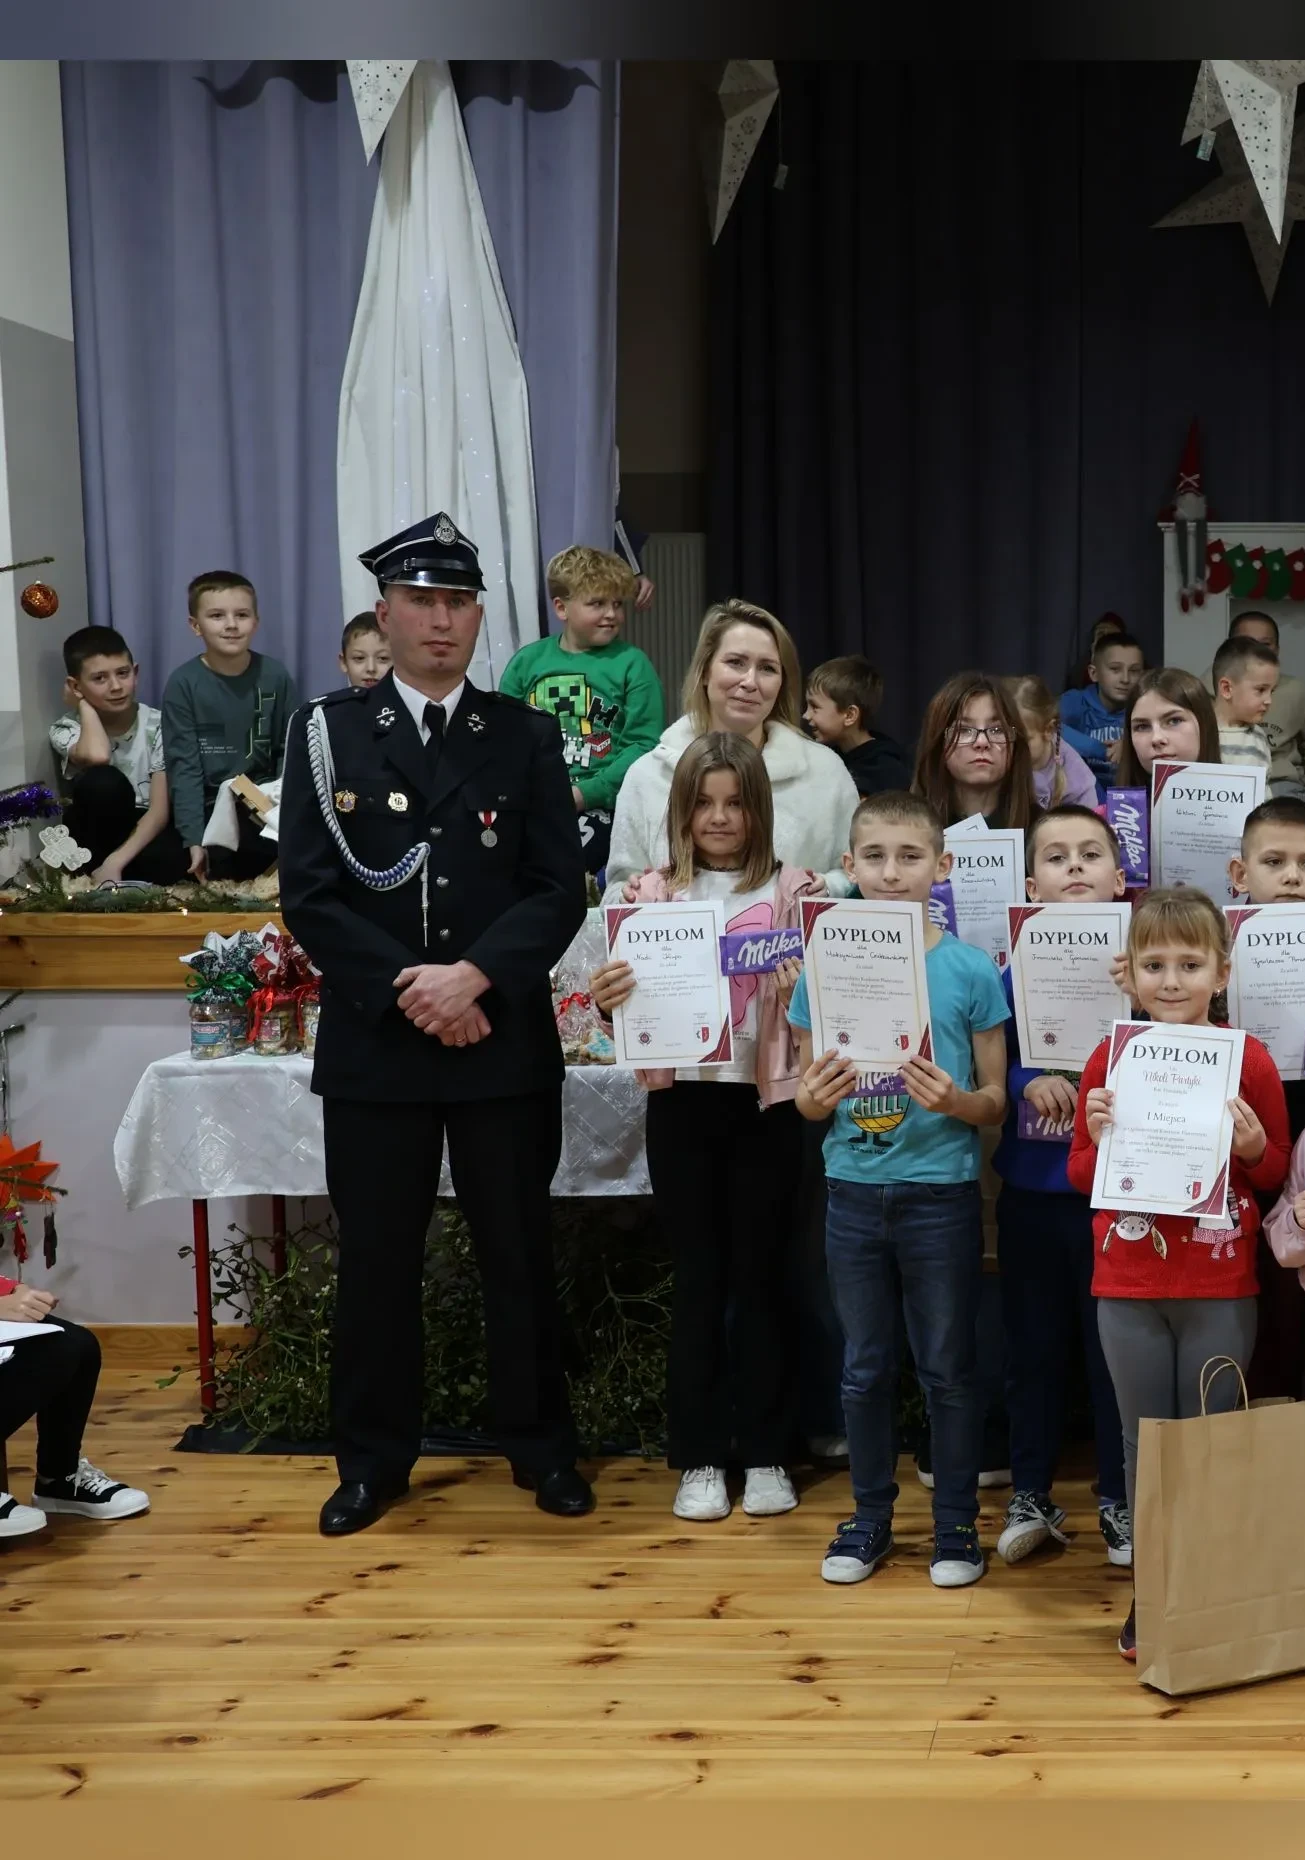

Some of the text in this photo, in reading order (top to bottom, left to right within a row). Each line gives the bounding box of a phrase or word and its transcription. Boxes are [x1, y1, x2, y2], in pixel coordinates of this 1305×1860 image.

[1171, 787, 1244, 804] DYPLOM
[1113, 803, 1146, 868] Milka
[957, 855, 1005, 869] PLOM
[627, 927, 705, 944] DYPLOM
[822, 926, 902, 944] DYPLOM
[1029, 931, 1110, 946] DYPLOM
[737, 932, 802, 968] Milka
[1132, 1043, 1219, 1066] DYPLOM
[851, 1094, 902, 1117] CHILL
[1153, 1113, 1186, 1126] Miejsca
